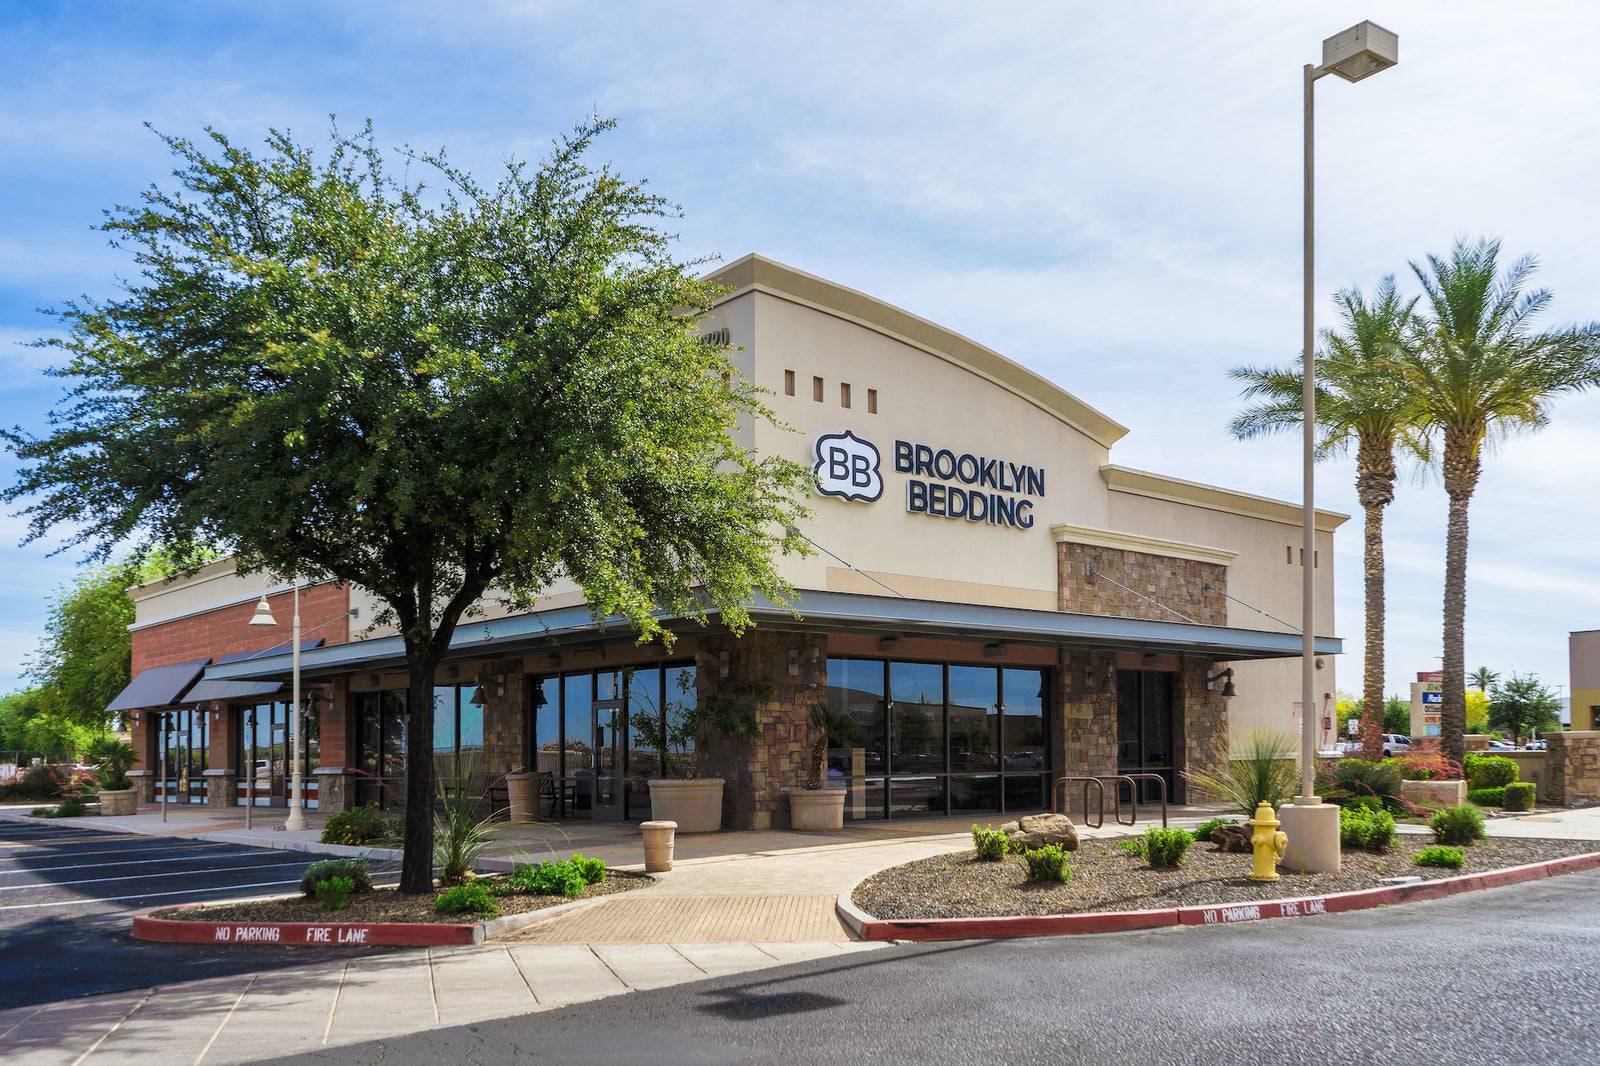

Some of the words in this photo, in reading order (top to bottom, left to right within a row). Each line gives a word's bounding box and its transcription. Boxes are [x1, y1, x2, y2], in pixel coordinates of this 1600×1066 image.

[829, 446, 872, 488] BB
[893, 440, 1045, 497] BROOKLYN
[907, 480, 1034, 529] BEDDING
[1203, 909, 1218, 923] NO
[1221, 906, 1260, 922] PARKING
[1280, 902, 1301, 917] FIRE
[1304, 900, 1327, 914] LANE
[215, 927, 231, 941] NO
[235, 927, 280, 941] PARKING
[306, 928, 332, 941] FIRE
[338, 928, 369, 943] LANE
